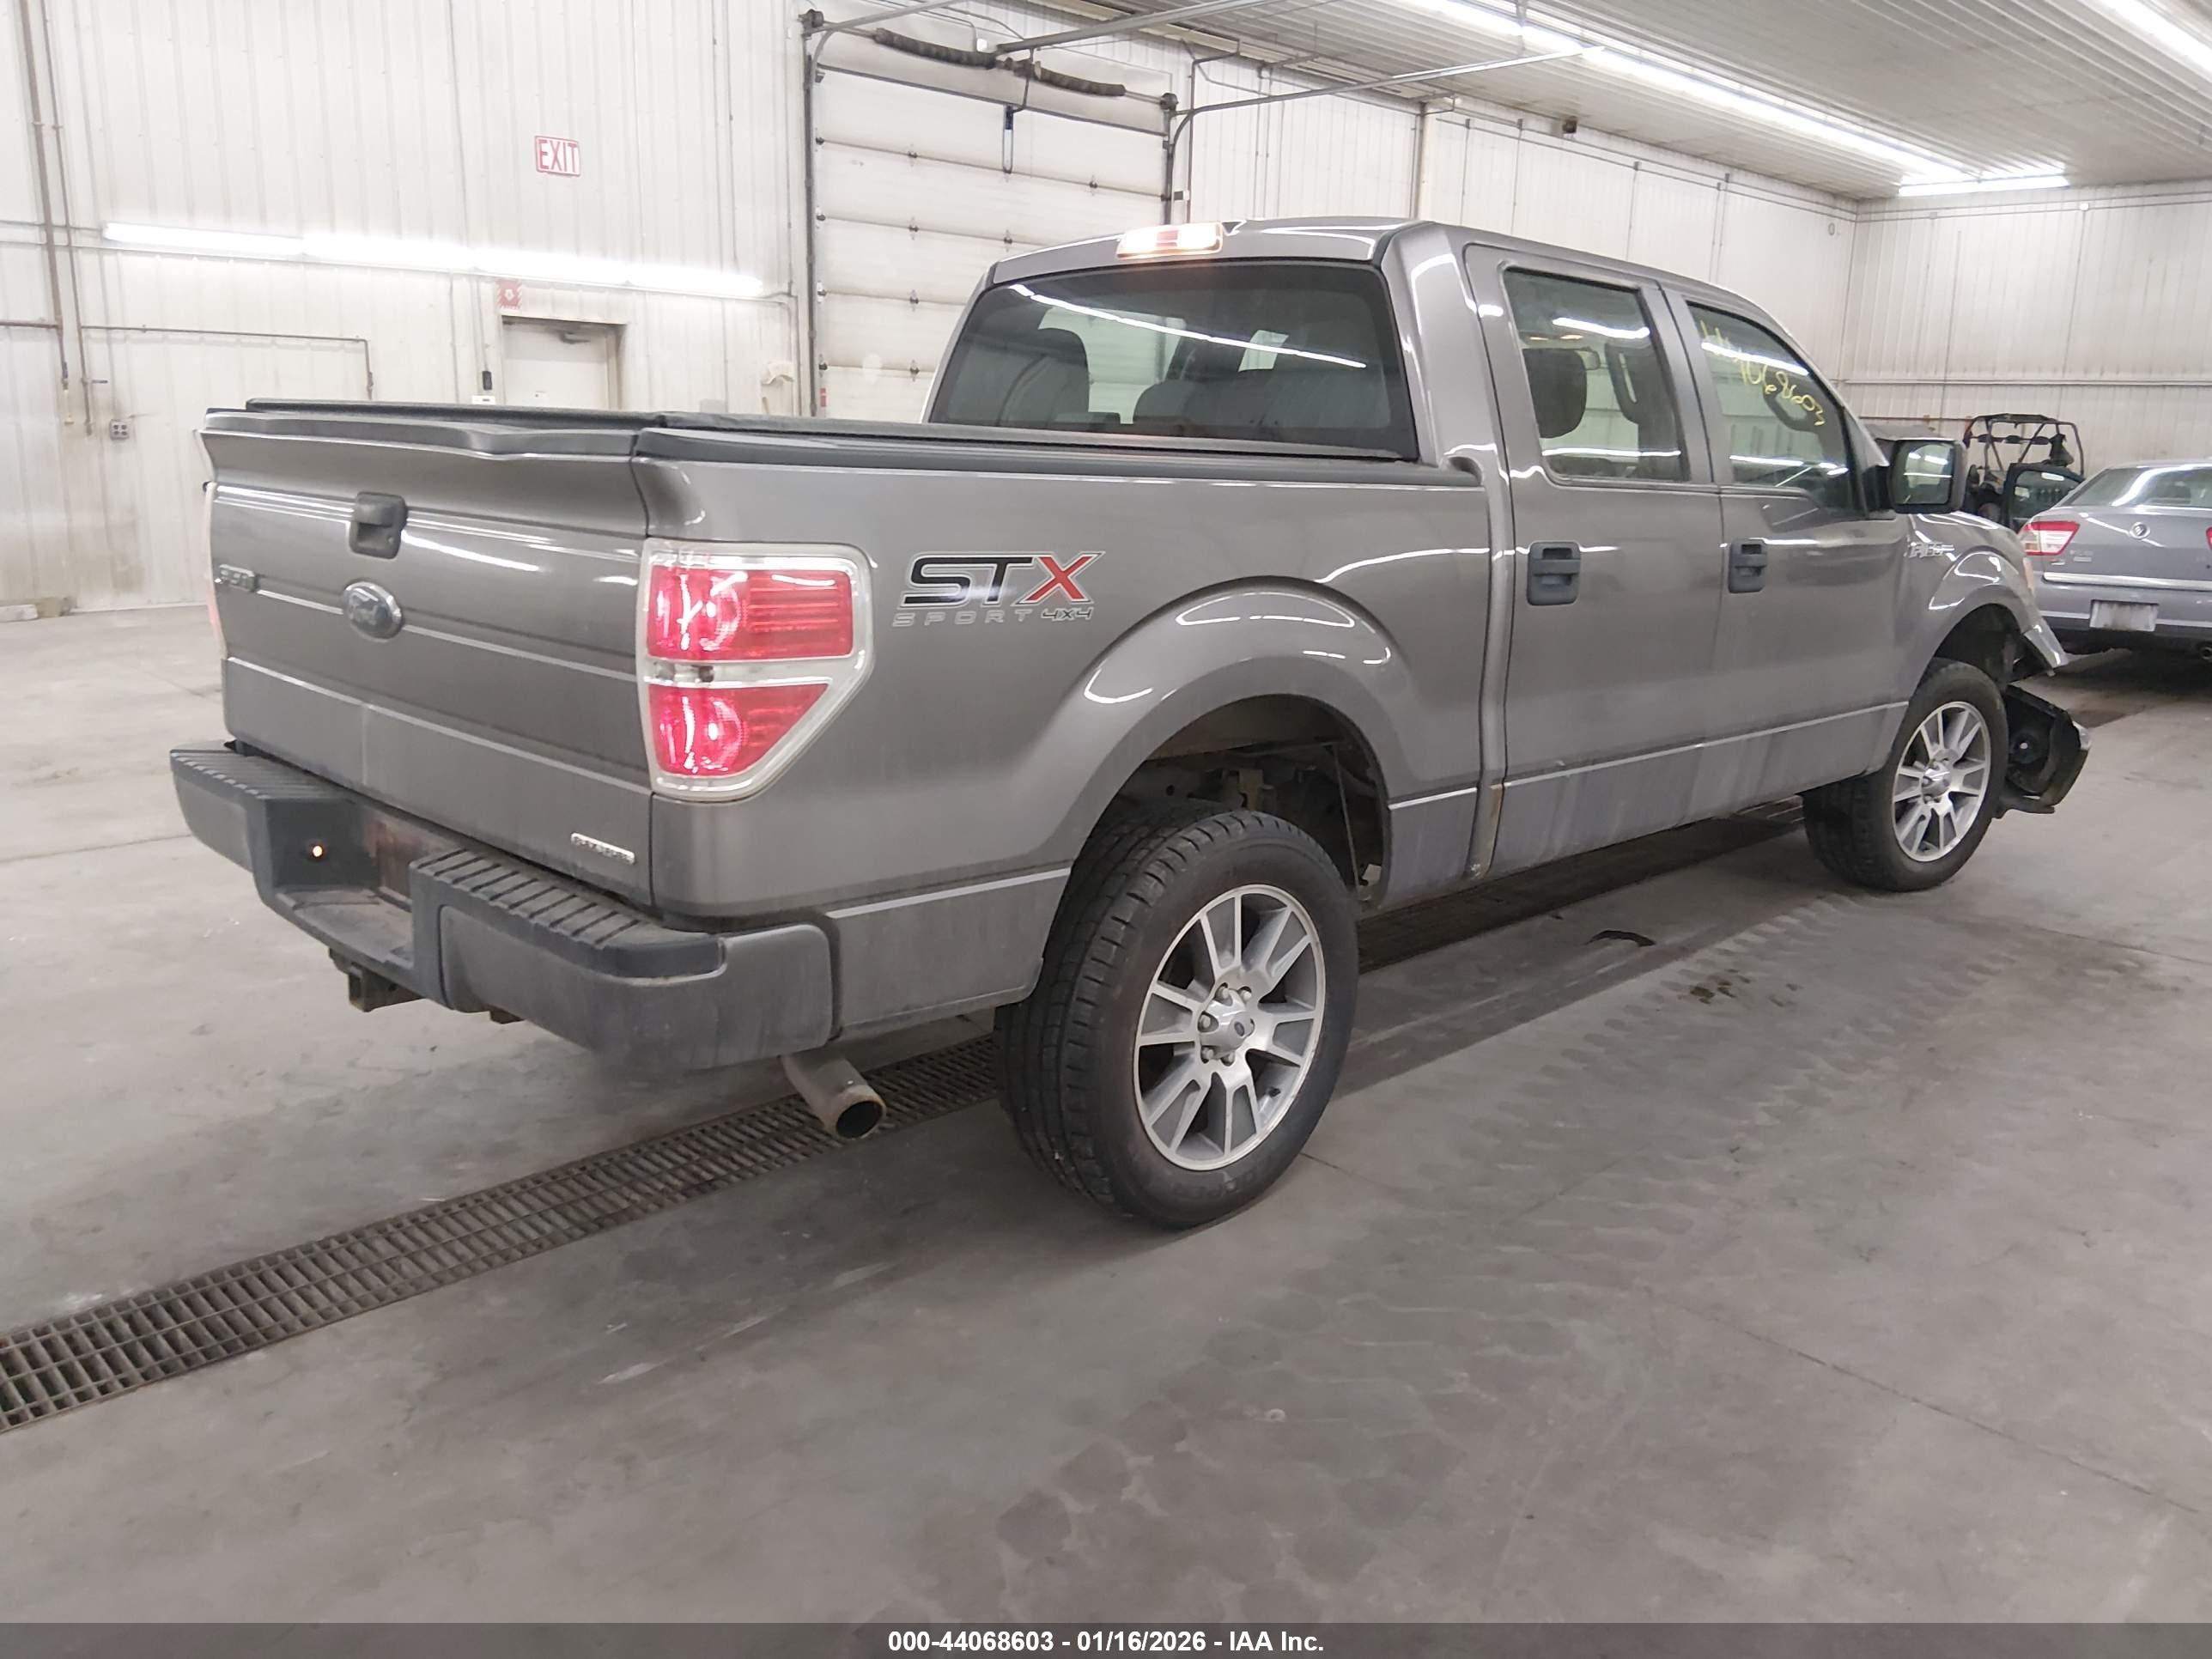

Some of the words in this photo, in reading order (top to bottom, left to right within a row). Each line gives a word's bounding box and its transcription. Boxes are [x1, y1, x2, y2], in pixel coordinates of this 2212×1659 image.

[538, 138, 578, 173] EXIT
[899, 551, 1104, 608] STX
[892, 609, 1033, 627] SPORT
